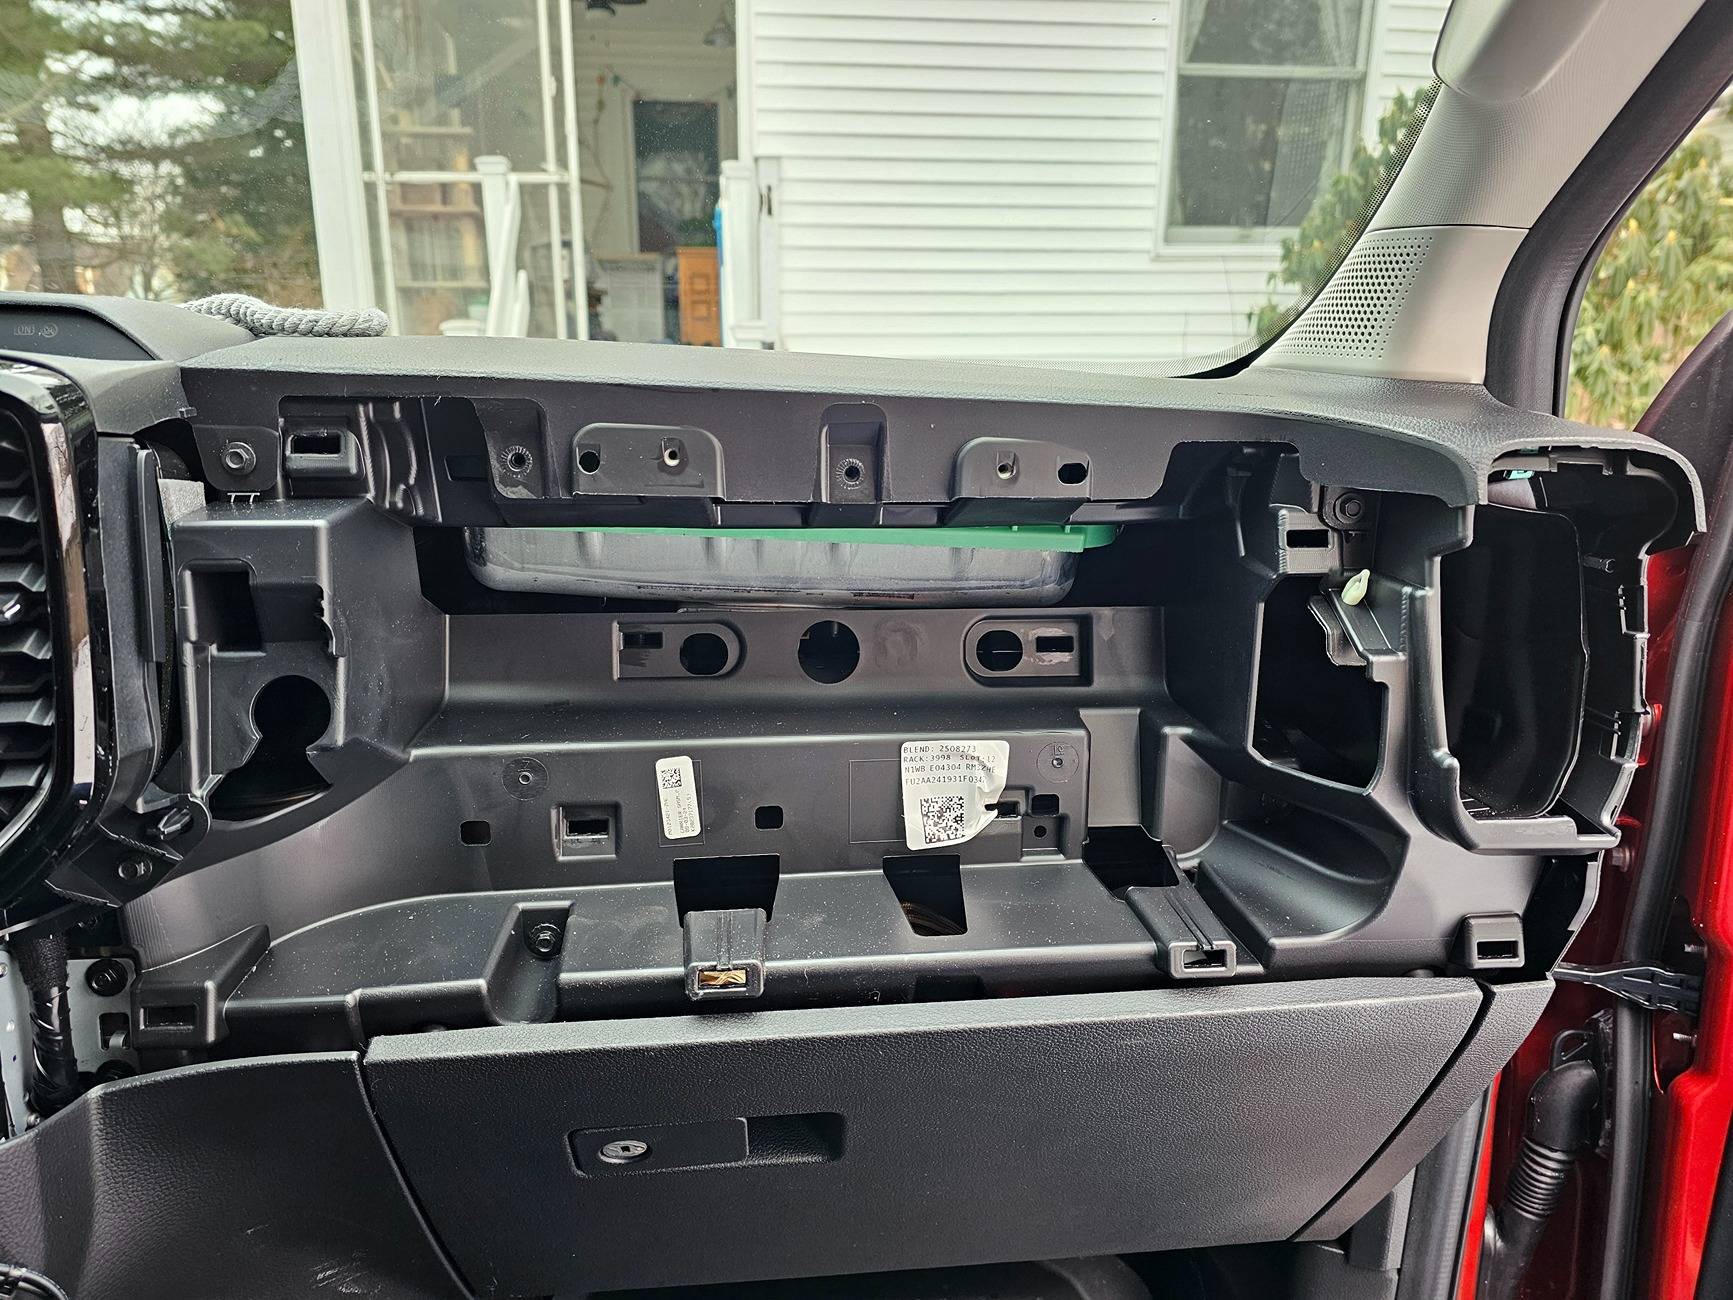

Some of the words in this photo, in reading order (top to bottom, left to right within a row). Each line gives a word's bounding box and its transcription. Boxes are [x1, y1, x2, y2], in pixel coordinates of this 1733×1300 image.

[903, 746, 934, 754] BLEND:
[939, 744, 976, 753] 2508273
[904, 765, 926, 774] N1WB
[929, 763, 961, 772] E04304
